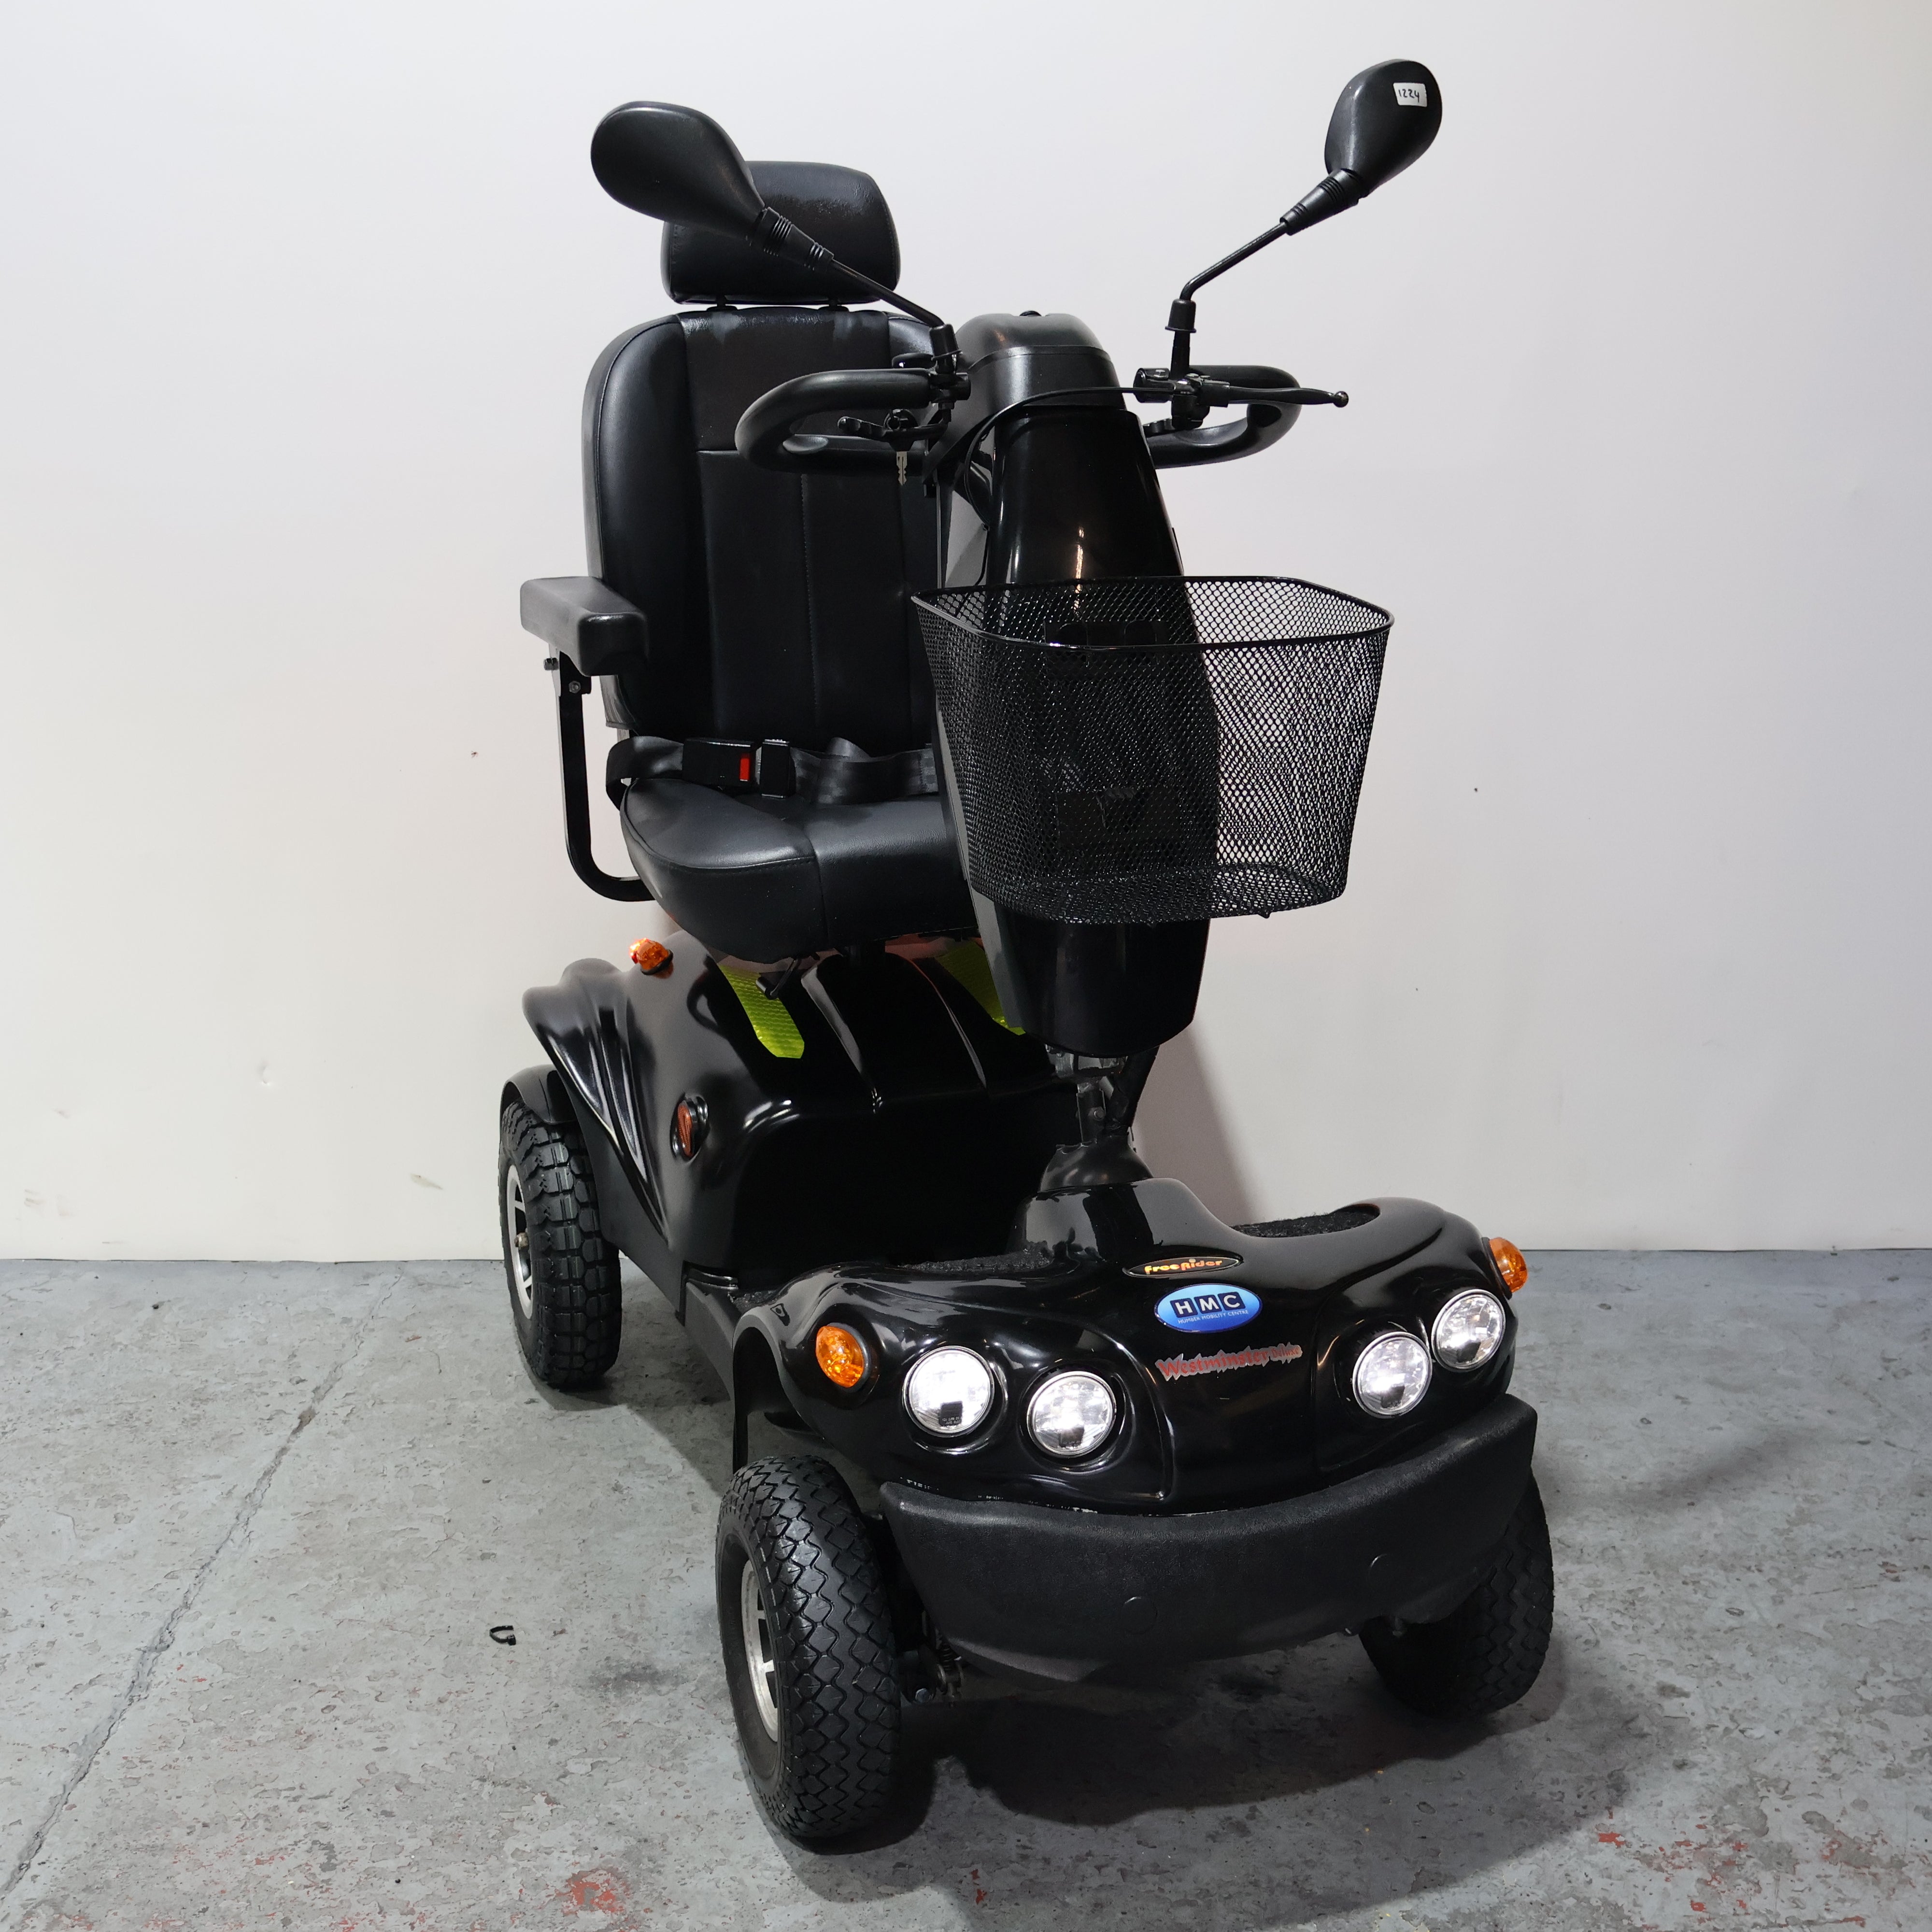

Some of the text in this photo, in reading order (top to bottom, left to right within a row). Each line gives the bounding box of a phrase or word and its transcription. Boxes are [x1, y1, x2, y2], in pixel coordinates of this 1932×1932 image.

[1398, 88, 1420, 103] 1224
[1175, 1294, 1240, 1315] HMC
[1158, 1351, 1268, 1376] Westminster
